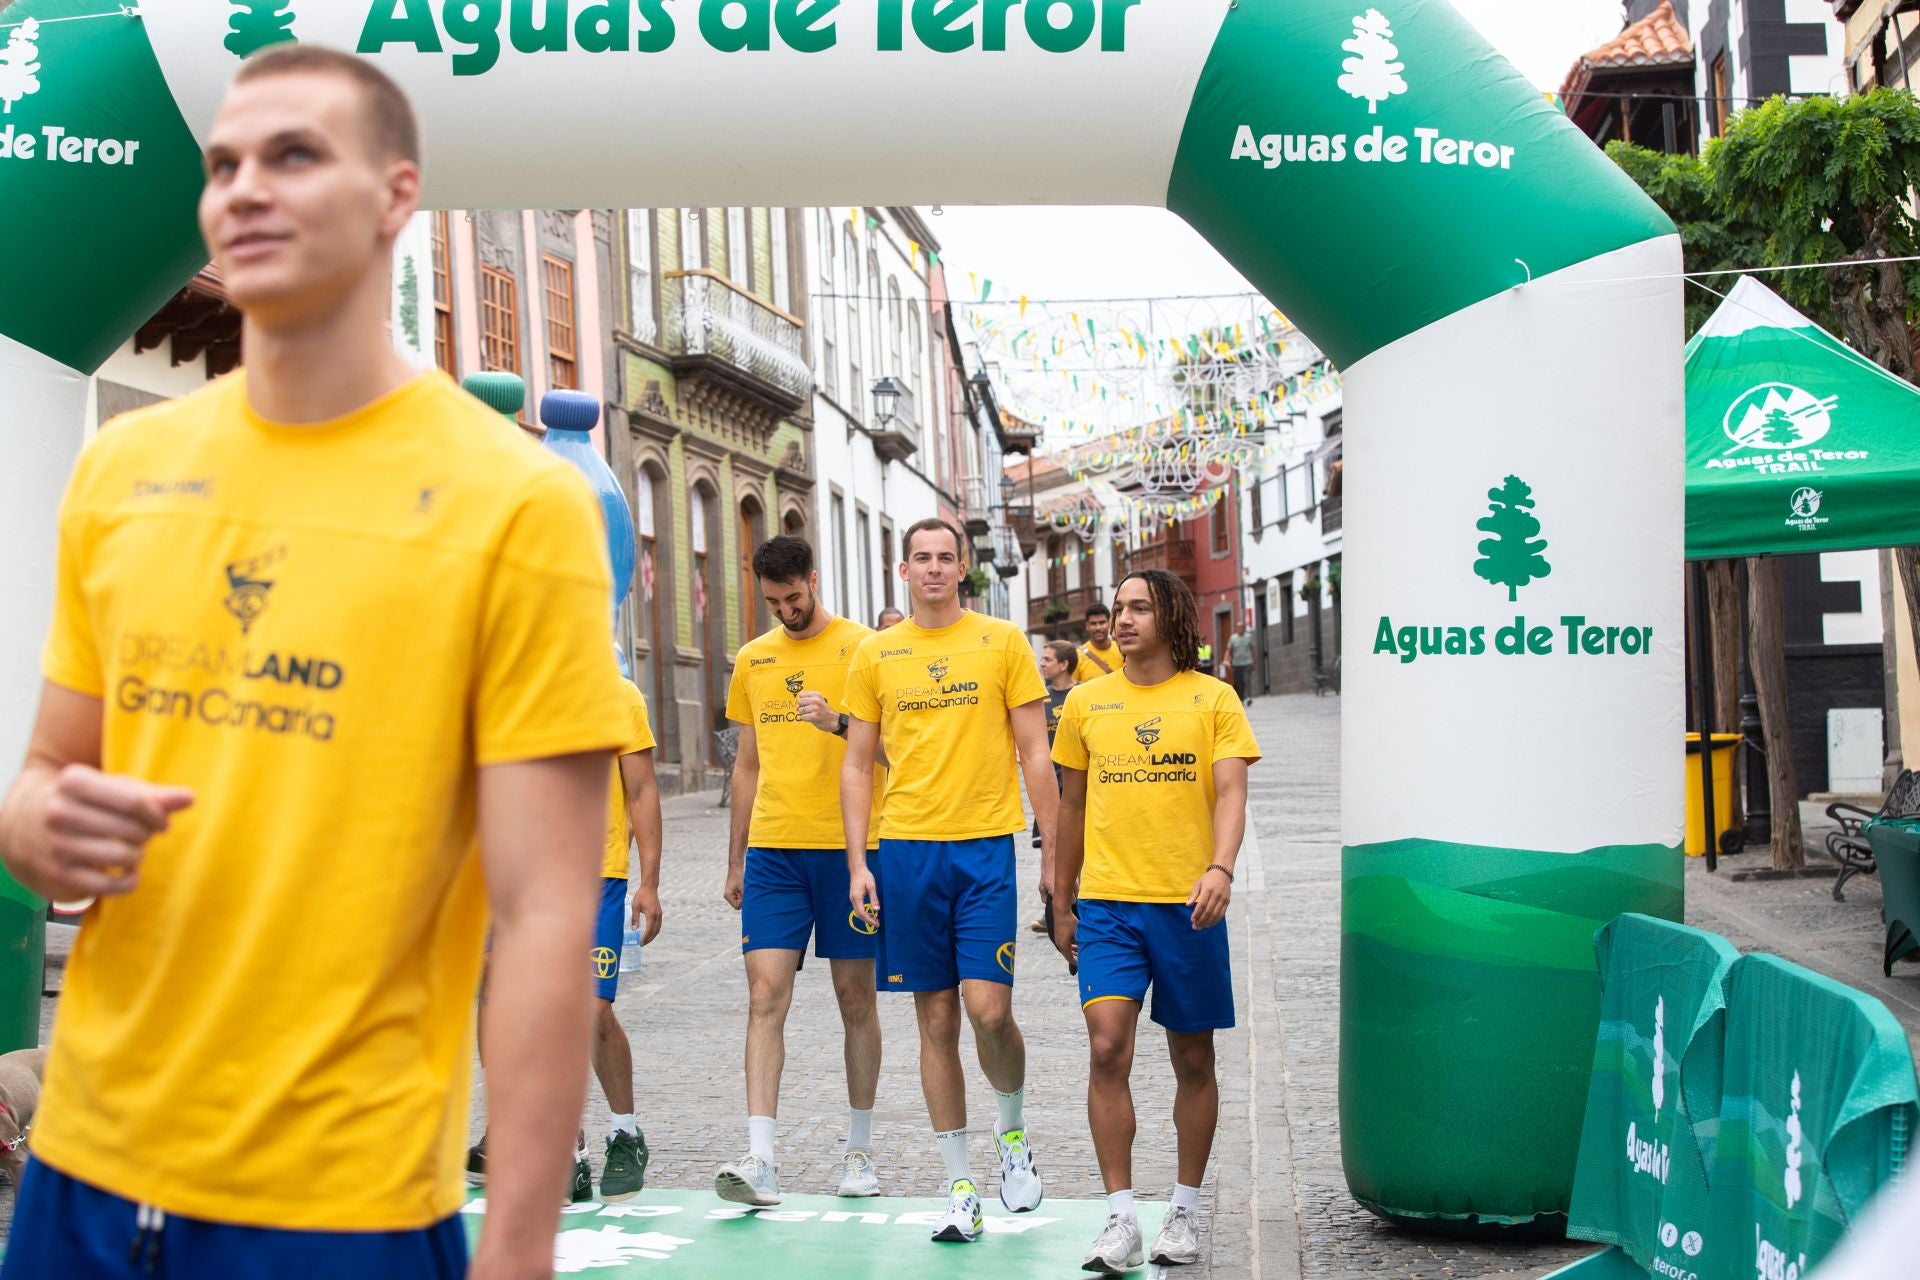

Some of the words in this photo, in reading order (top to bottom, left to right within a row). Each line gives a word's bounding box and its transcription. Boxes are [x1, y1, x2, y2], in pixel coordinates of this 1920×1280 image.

[355, 0, 676, 76] Aguas
[41, 125, 140, 165] Teror
[1229, 124, 1347, 170] Aguas
[1353, 125, 1409, 163] de
[1414, 127, 1515, 169] Teror
[1704, 454, 1774, 469] Aguas
[1777, 450, 1808, 462] de
[1809, 448, 1869, 461] Teror
[1754, 461, 1825, 475] TRAIL
[1785, 518, 1804, 526] Aguas
[1813, 516, 1829, 524] Teror
[1373, 616, 1486, 664] Aguas
[1495, 616, 1554, 656] de
[1560, 616, 1653, 656] Teror
[750, 656, 777, 667] SPALDING
[880, 648, 913, 658] SPALDING
[116, 675, 193, 720] Gran
[896, 681, 979, 699] DREAMLAND
[897, 700, 928, 712] Gran
[928, 694, 979, 709] Canaria
[1089, 702, 1125, 712] SPALDING
[759, 712, 785, 724] Gran
[1098, 753, 1197, 767] DREAMLAND
[1098, 770, 1133, 784] Gran
[1134, 768, 1197, 783] Canaria
